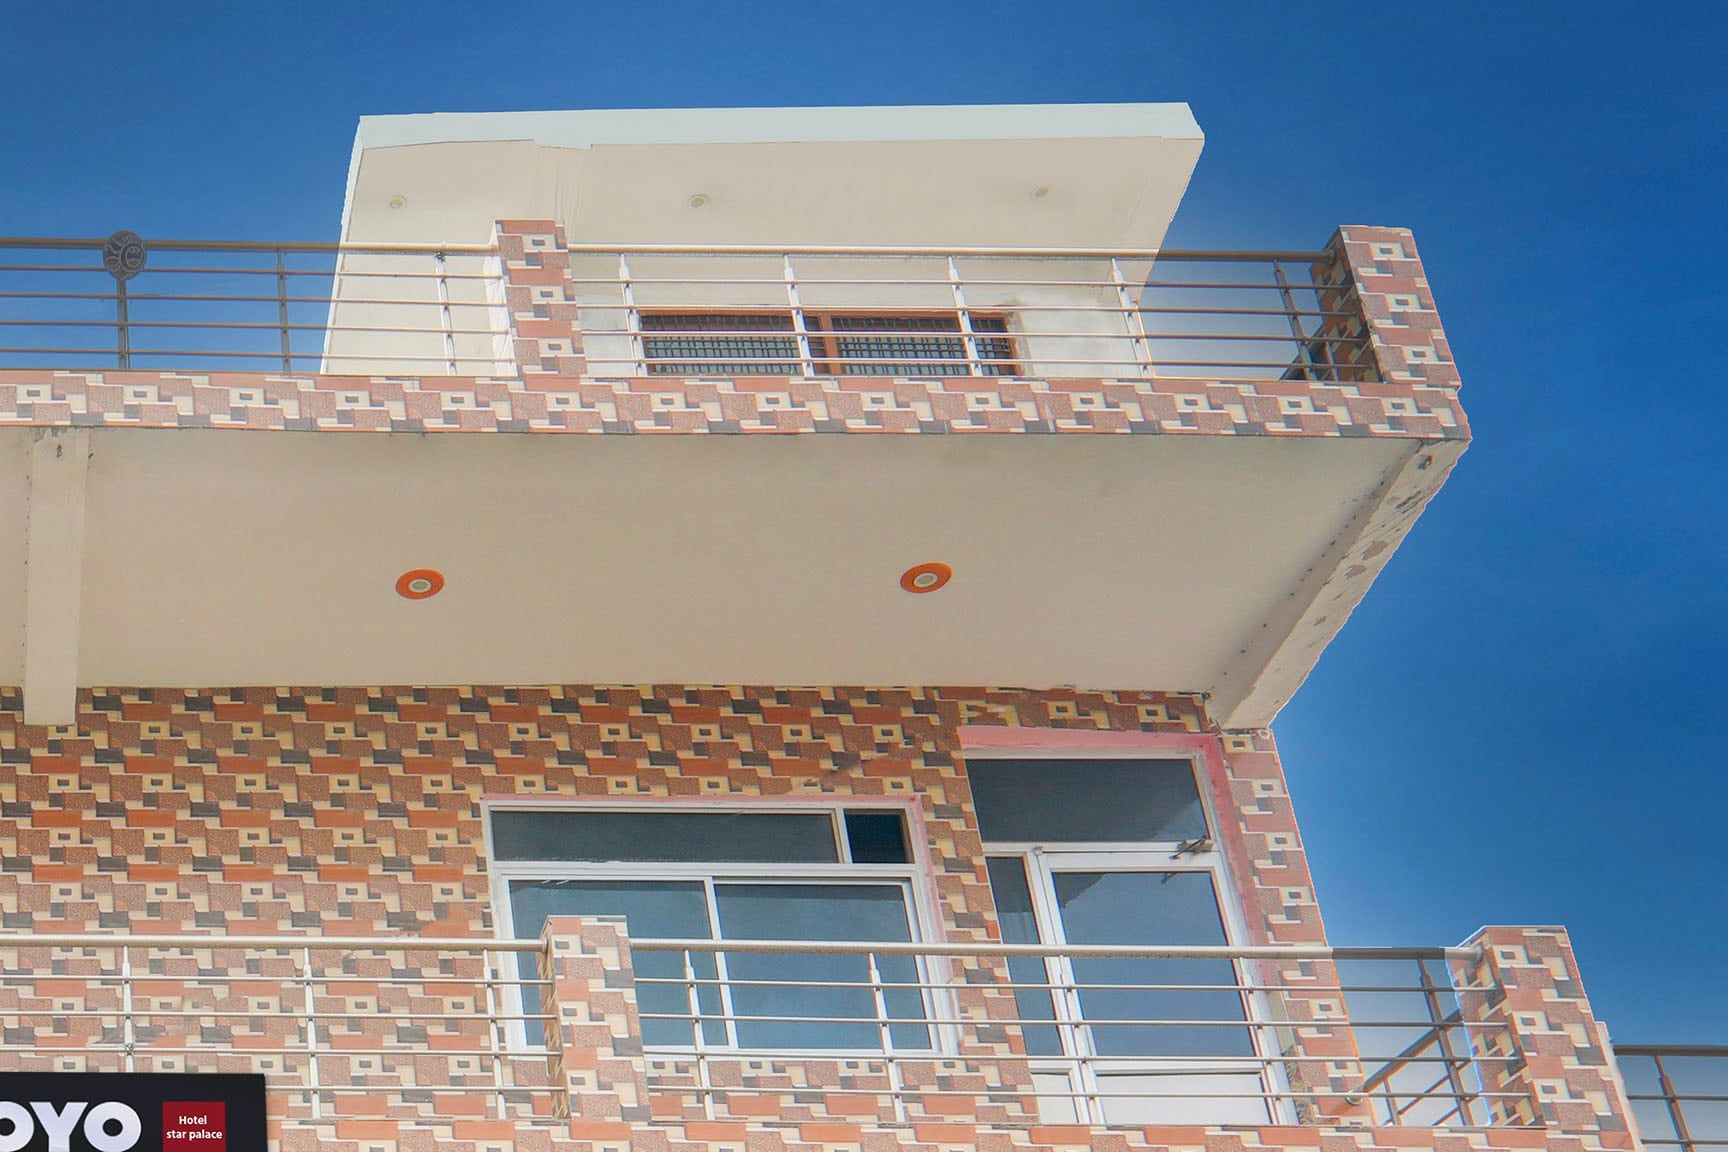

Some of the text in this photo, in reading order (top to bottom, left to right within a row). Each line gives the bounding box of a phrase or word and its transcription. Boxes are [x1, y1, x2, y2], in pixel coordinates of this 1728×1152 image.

[178, 1114, 208, 1126] Hotel
[166, 1129, 223, 1141] star palace
